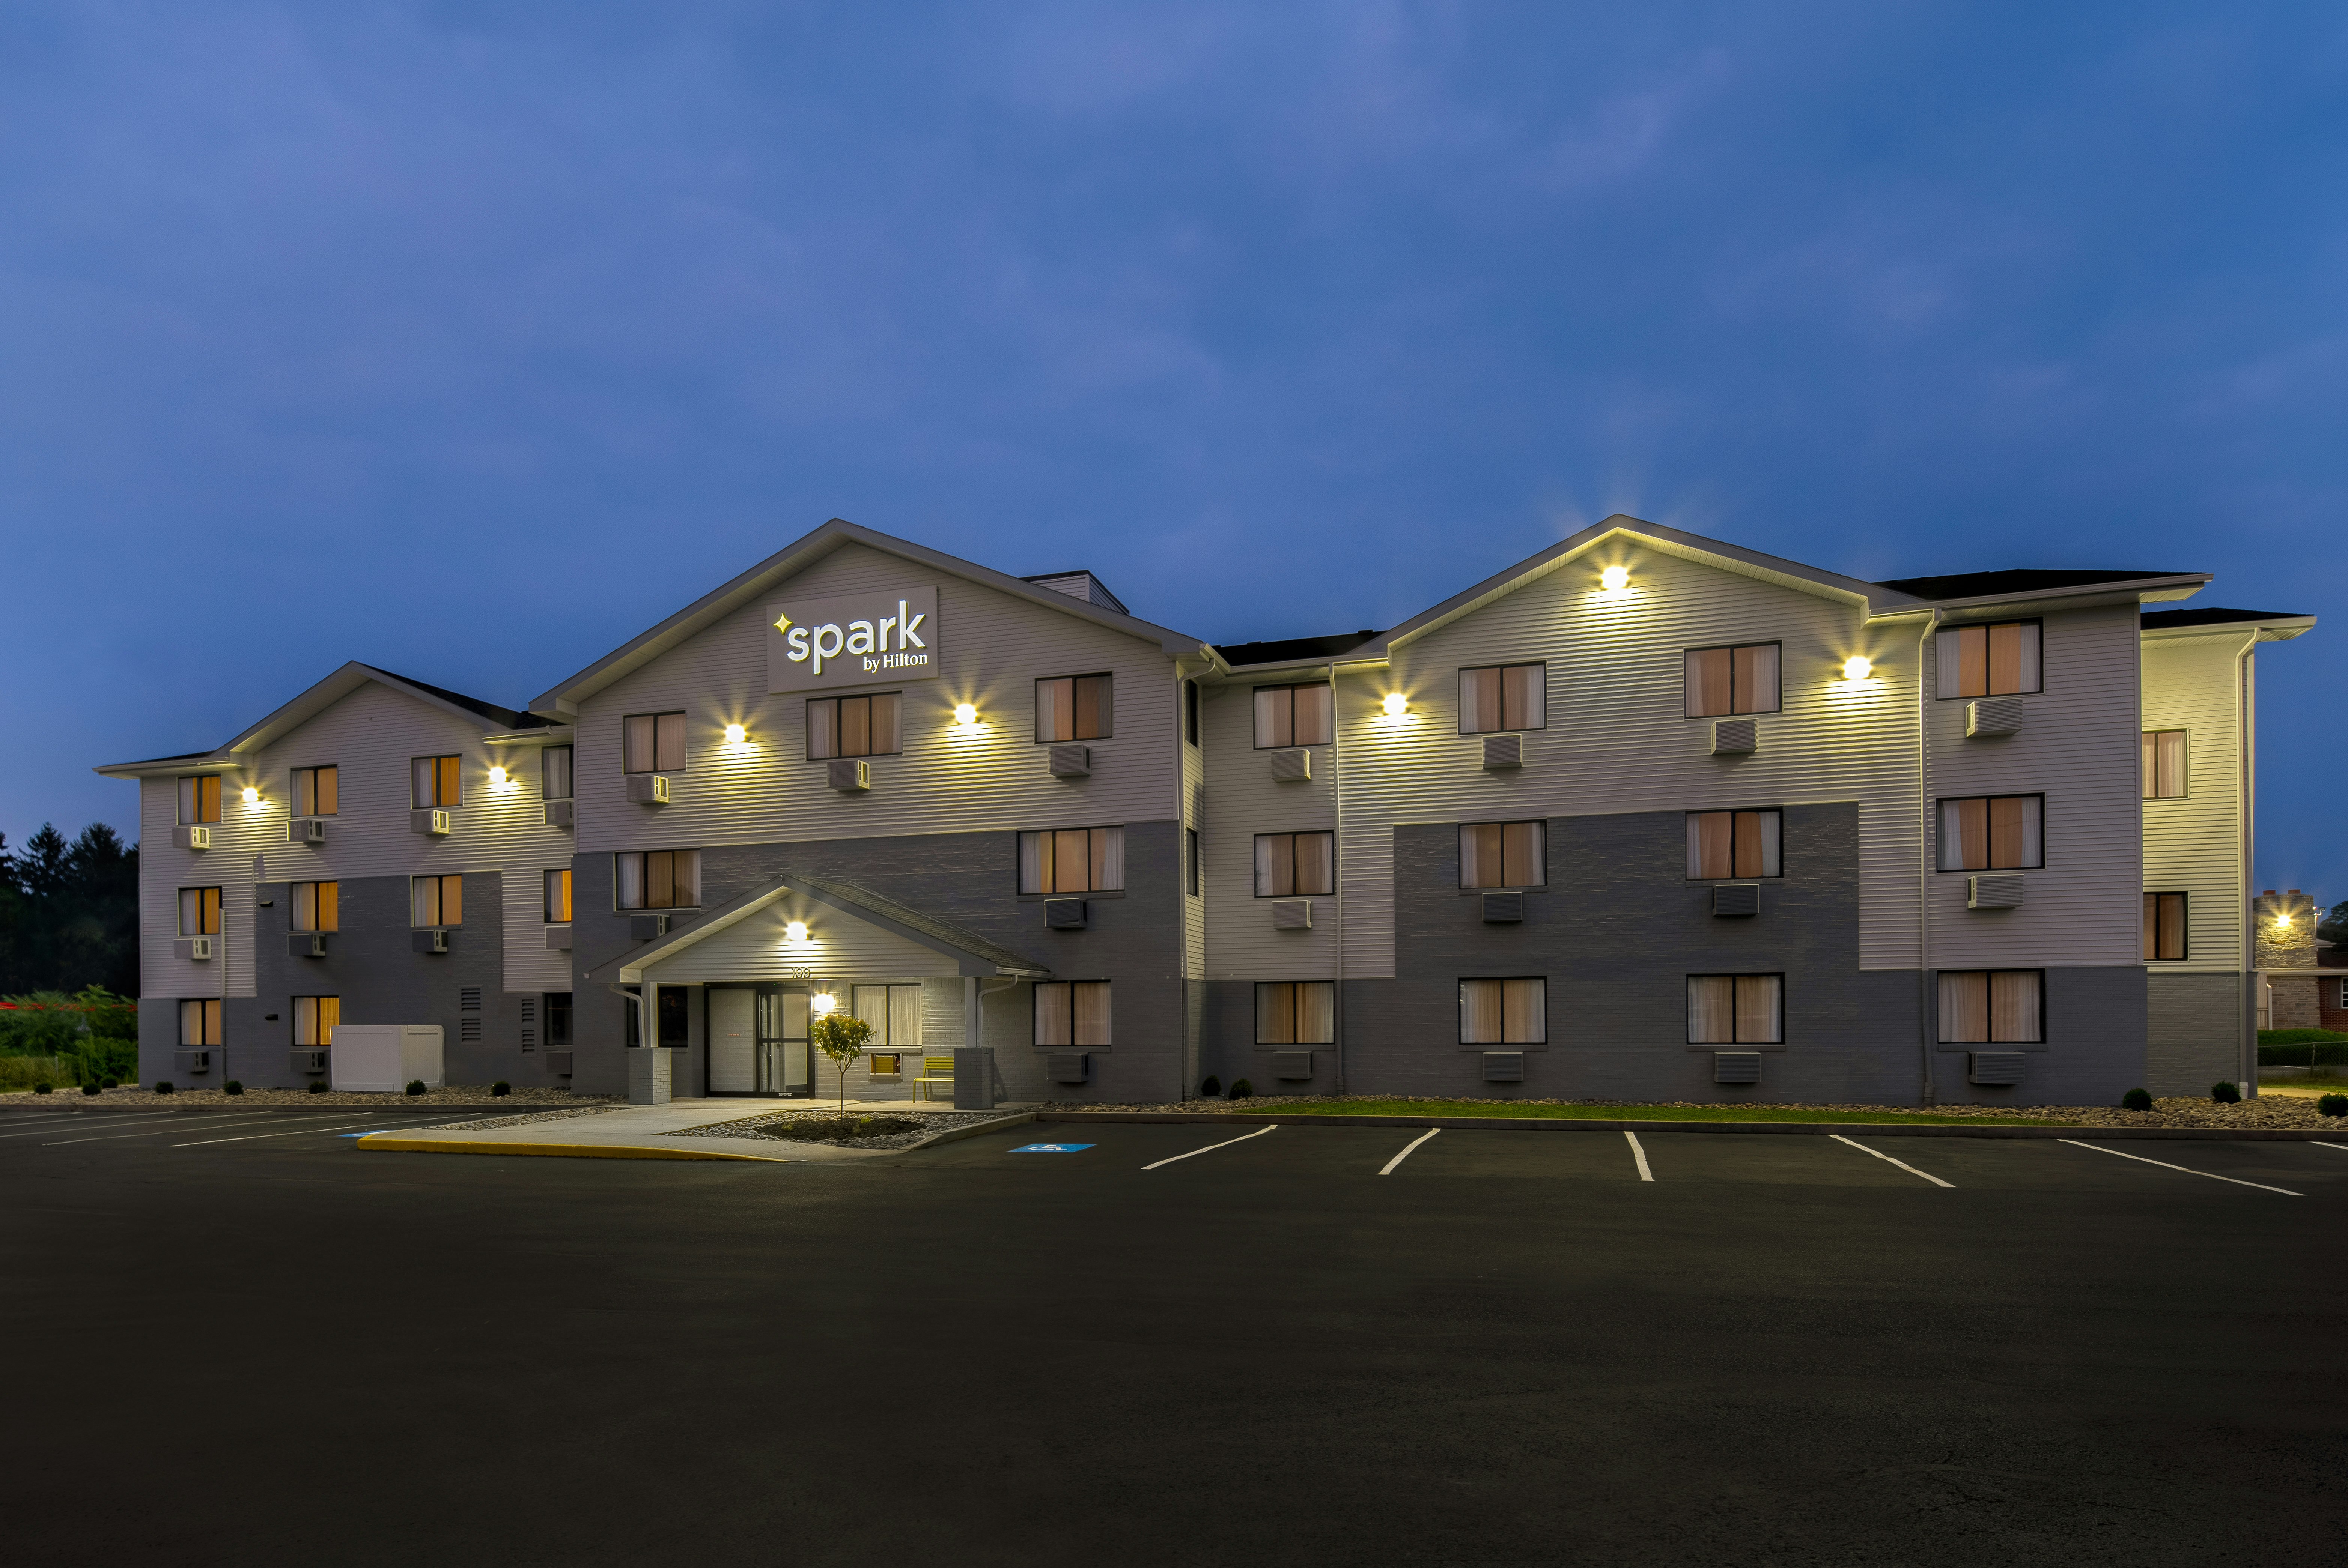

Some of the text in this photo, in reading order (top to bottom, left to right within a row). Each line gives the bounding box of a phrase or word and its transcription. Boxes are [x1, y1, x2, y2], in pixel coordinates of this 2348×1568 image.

[787, 600, 926, 675] spark
[864, 653, 928, 673] by Hilton
[792, 967, 810, 976] 100
